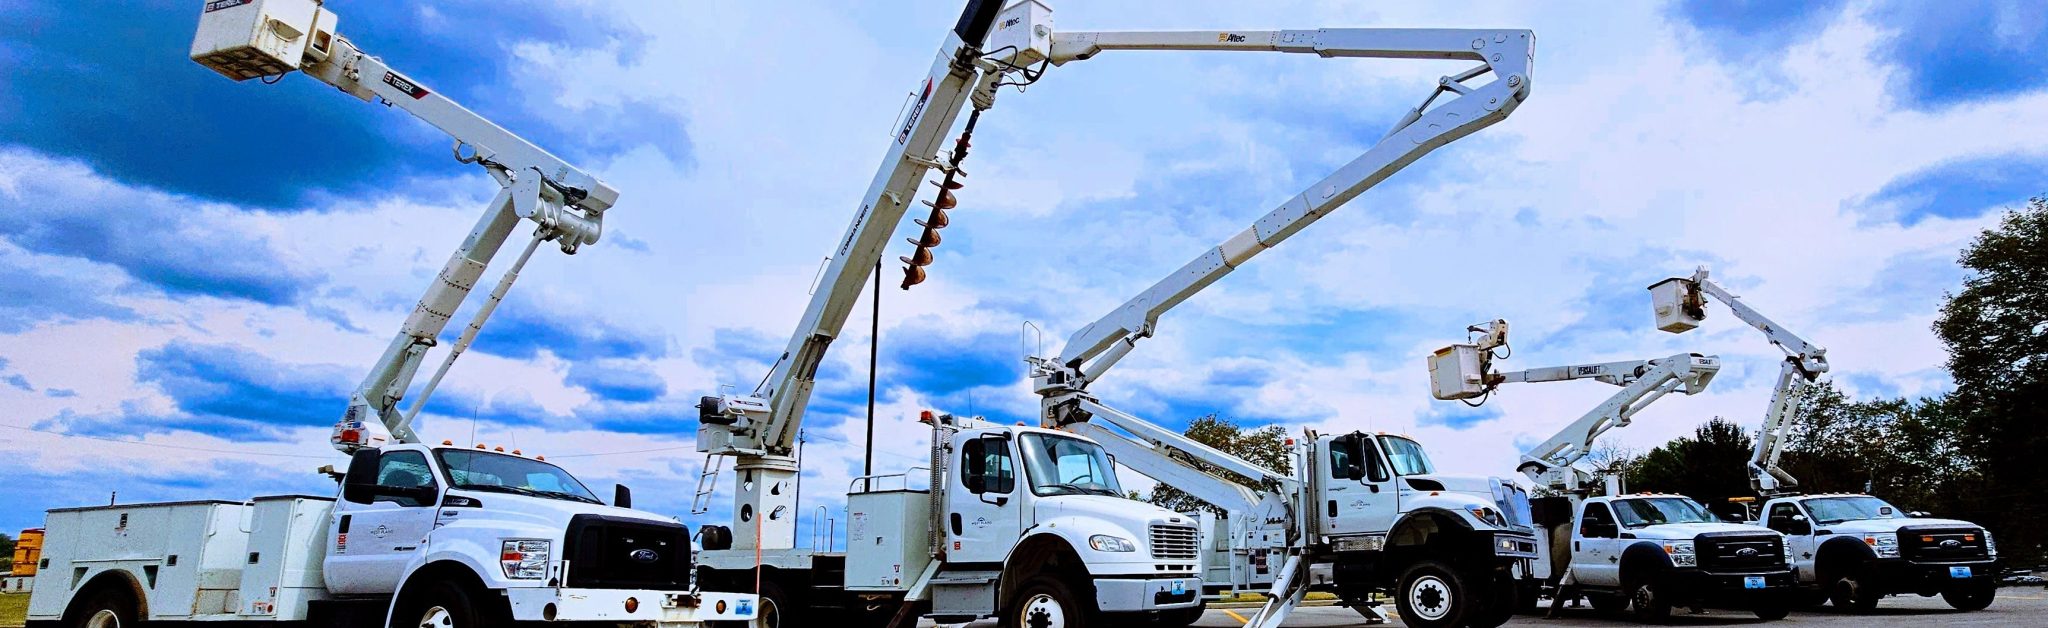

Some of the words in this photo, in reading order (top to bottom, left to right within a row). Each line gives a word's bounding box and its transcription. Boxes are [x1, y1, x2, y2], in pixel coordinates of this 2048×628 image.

[1005, 17, 1020, 29] Altec
[1226, 33, 1246, 42] Altec
[391, 76, 414, 93] TEREX
[904, 100, 924, 131] TEREX
[841, 204, 869, 256] COMMANDER
